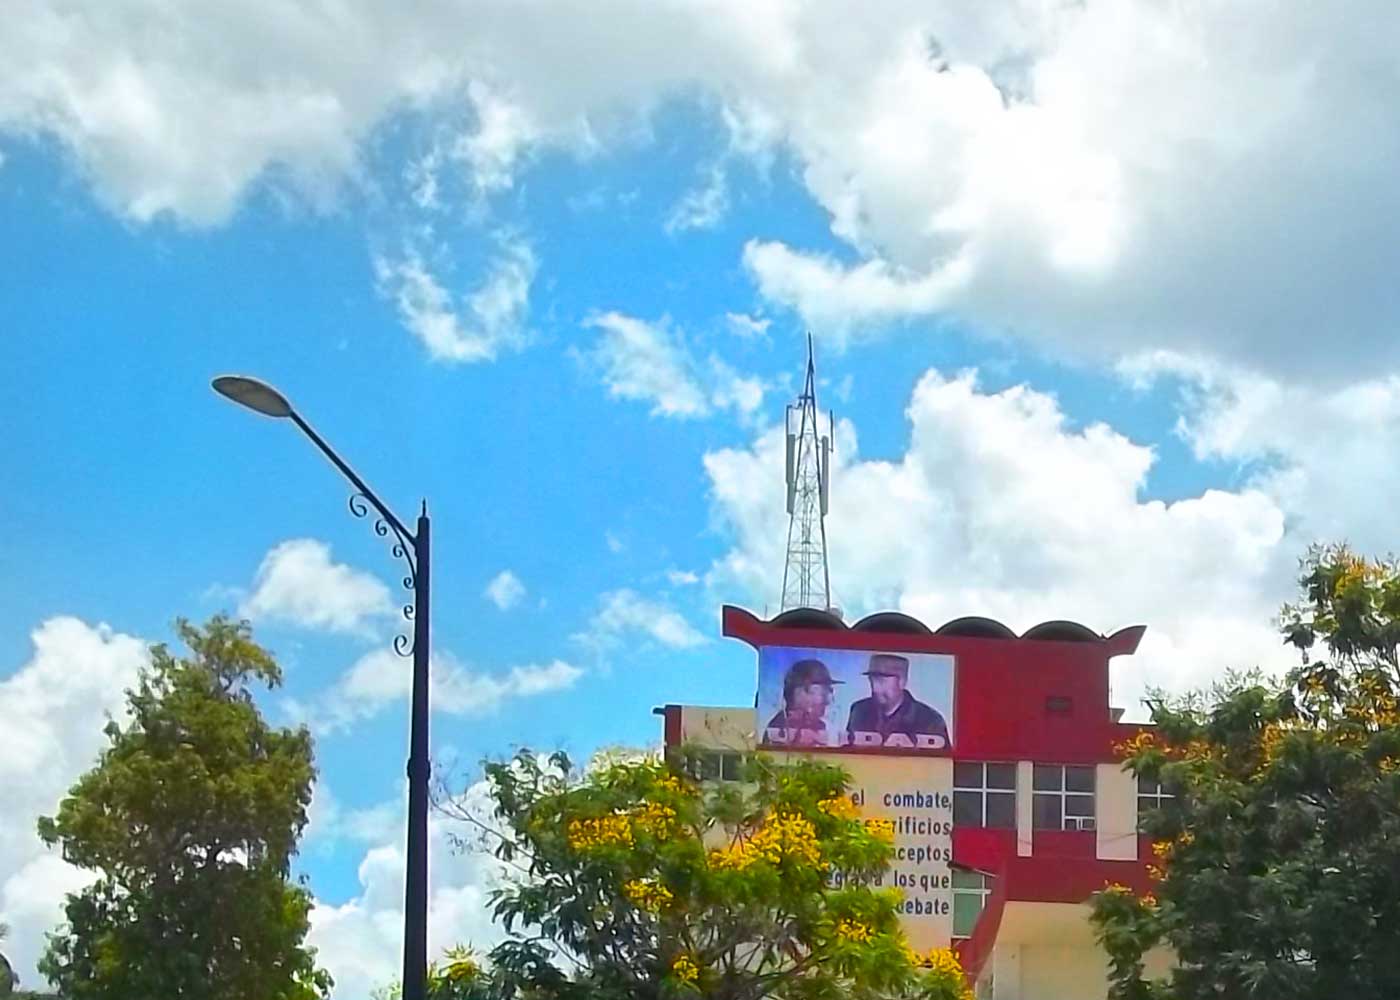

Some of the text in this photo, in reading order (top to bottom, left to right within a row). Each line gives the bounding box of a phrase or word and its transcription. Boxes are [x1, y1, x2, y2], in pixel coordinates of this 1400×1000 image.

[851, 789, 952, 812] el combate,
[894, 870, 916, 888] los
[920, 874, 950, 892] que
